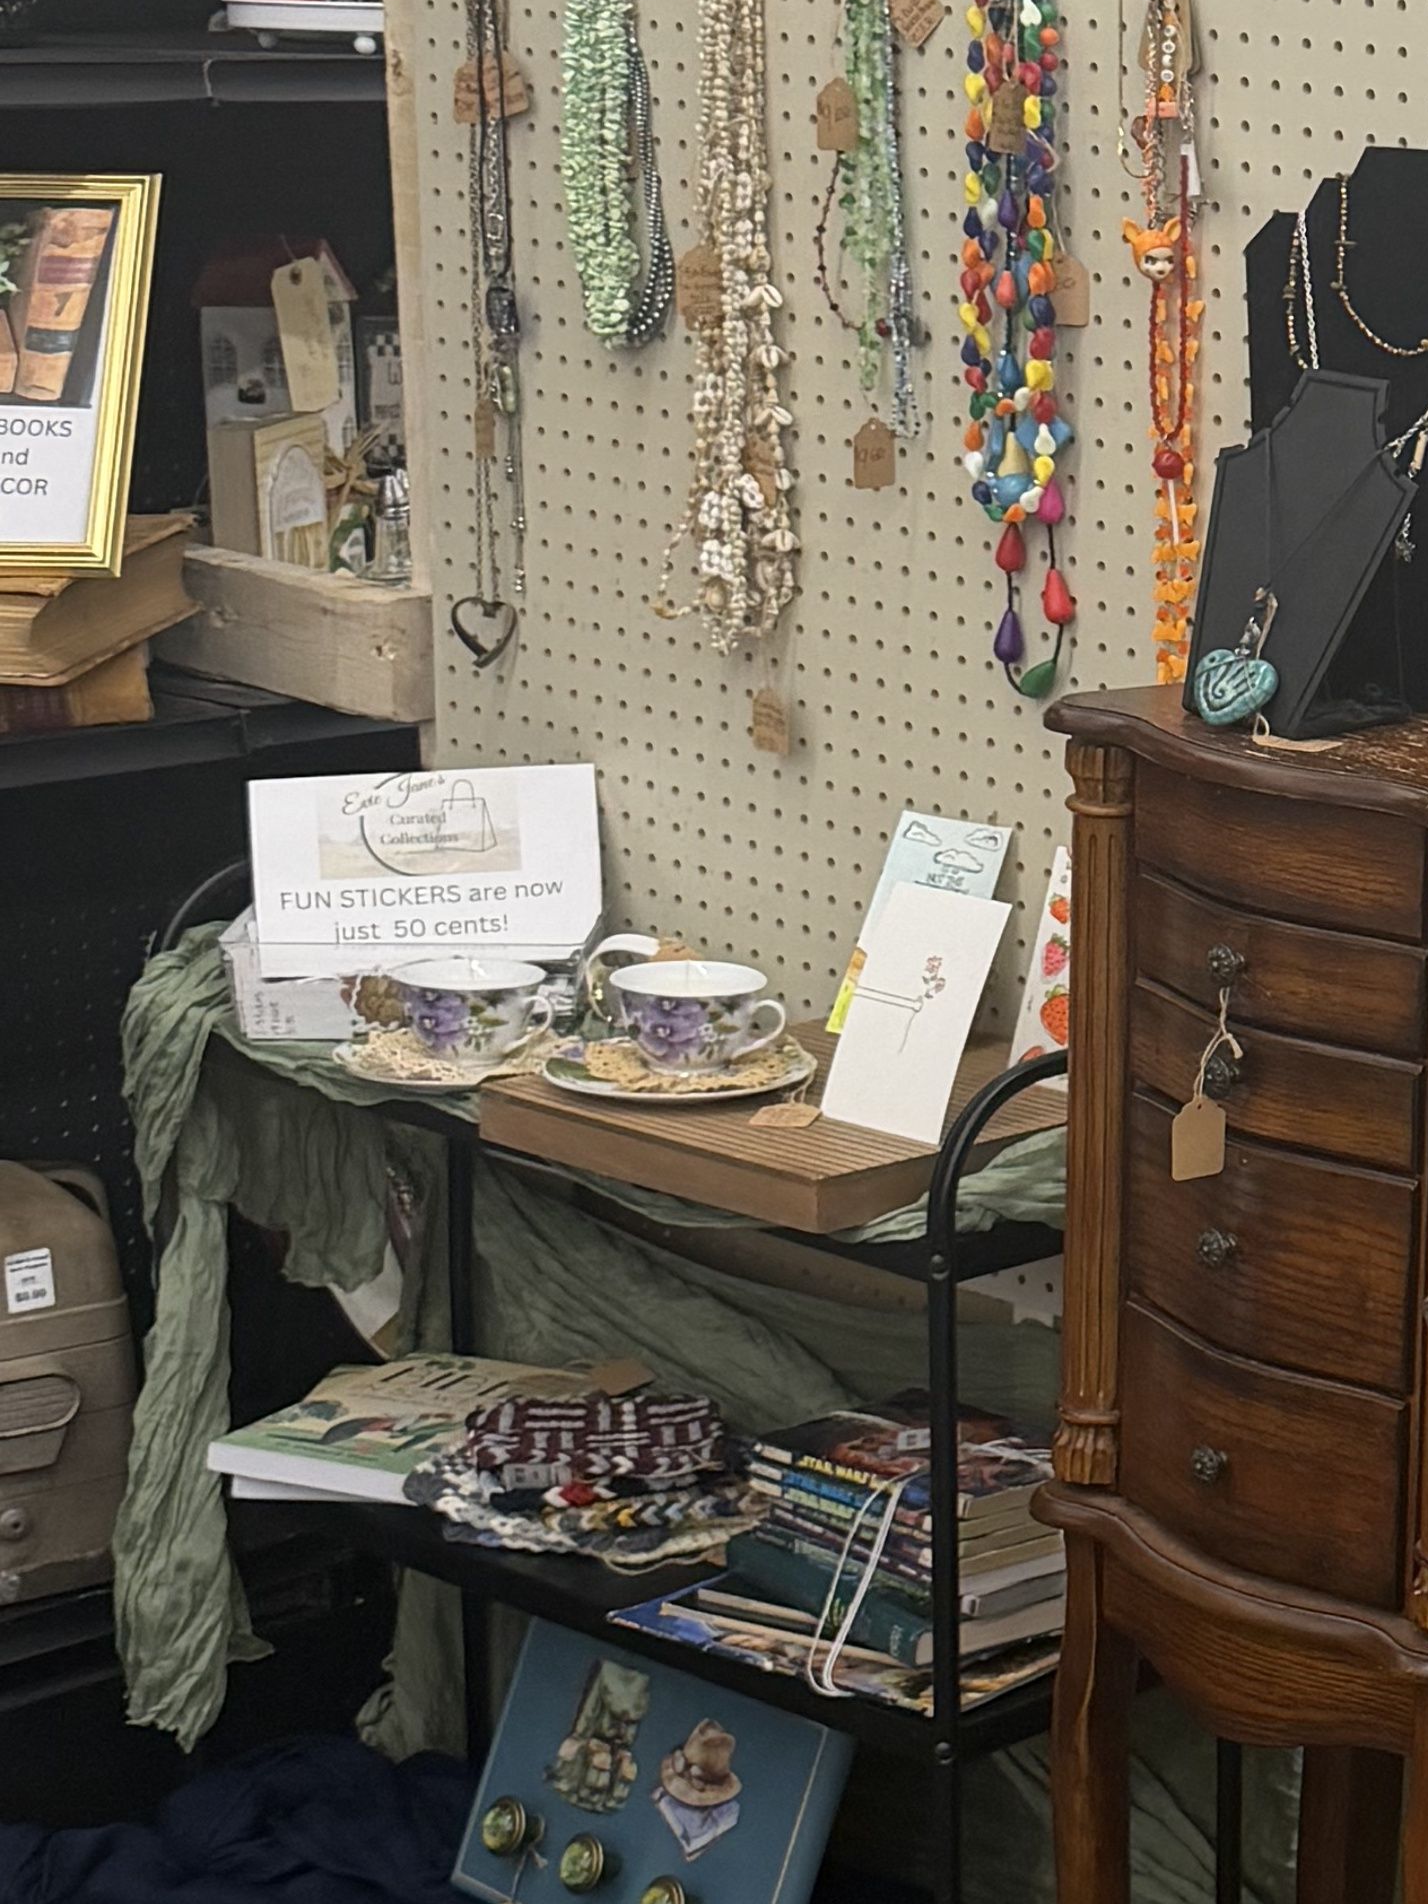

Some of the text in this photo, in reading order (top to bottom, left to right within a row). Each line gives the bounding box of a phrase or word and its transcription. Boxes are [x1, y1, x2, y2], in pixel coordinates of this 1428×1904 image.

[0, 418, 73, 437] BOOKS
[1, 448, 30, 465] nd
[0, 477, 48, 496] COR
[389, 812, 447, 825] Curated
[280, 880, 563, 911] FUN STICKERS are now
[334, 914, 510, 944] just 50 cents!
[800, 1454, 868, 1485] STAR WARS
